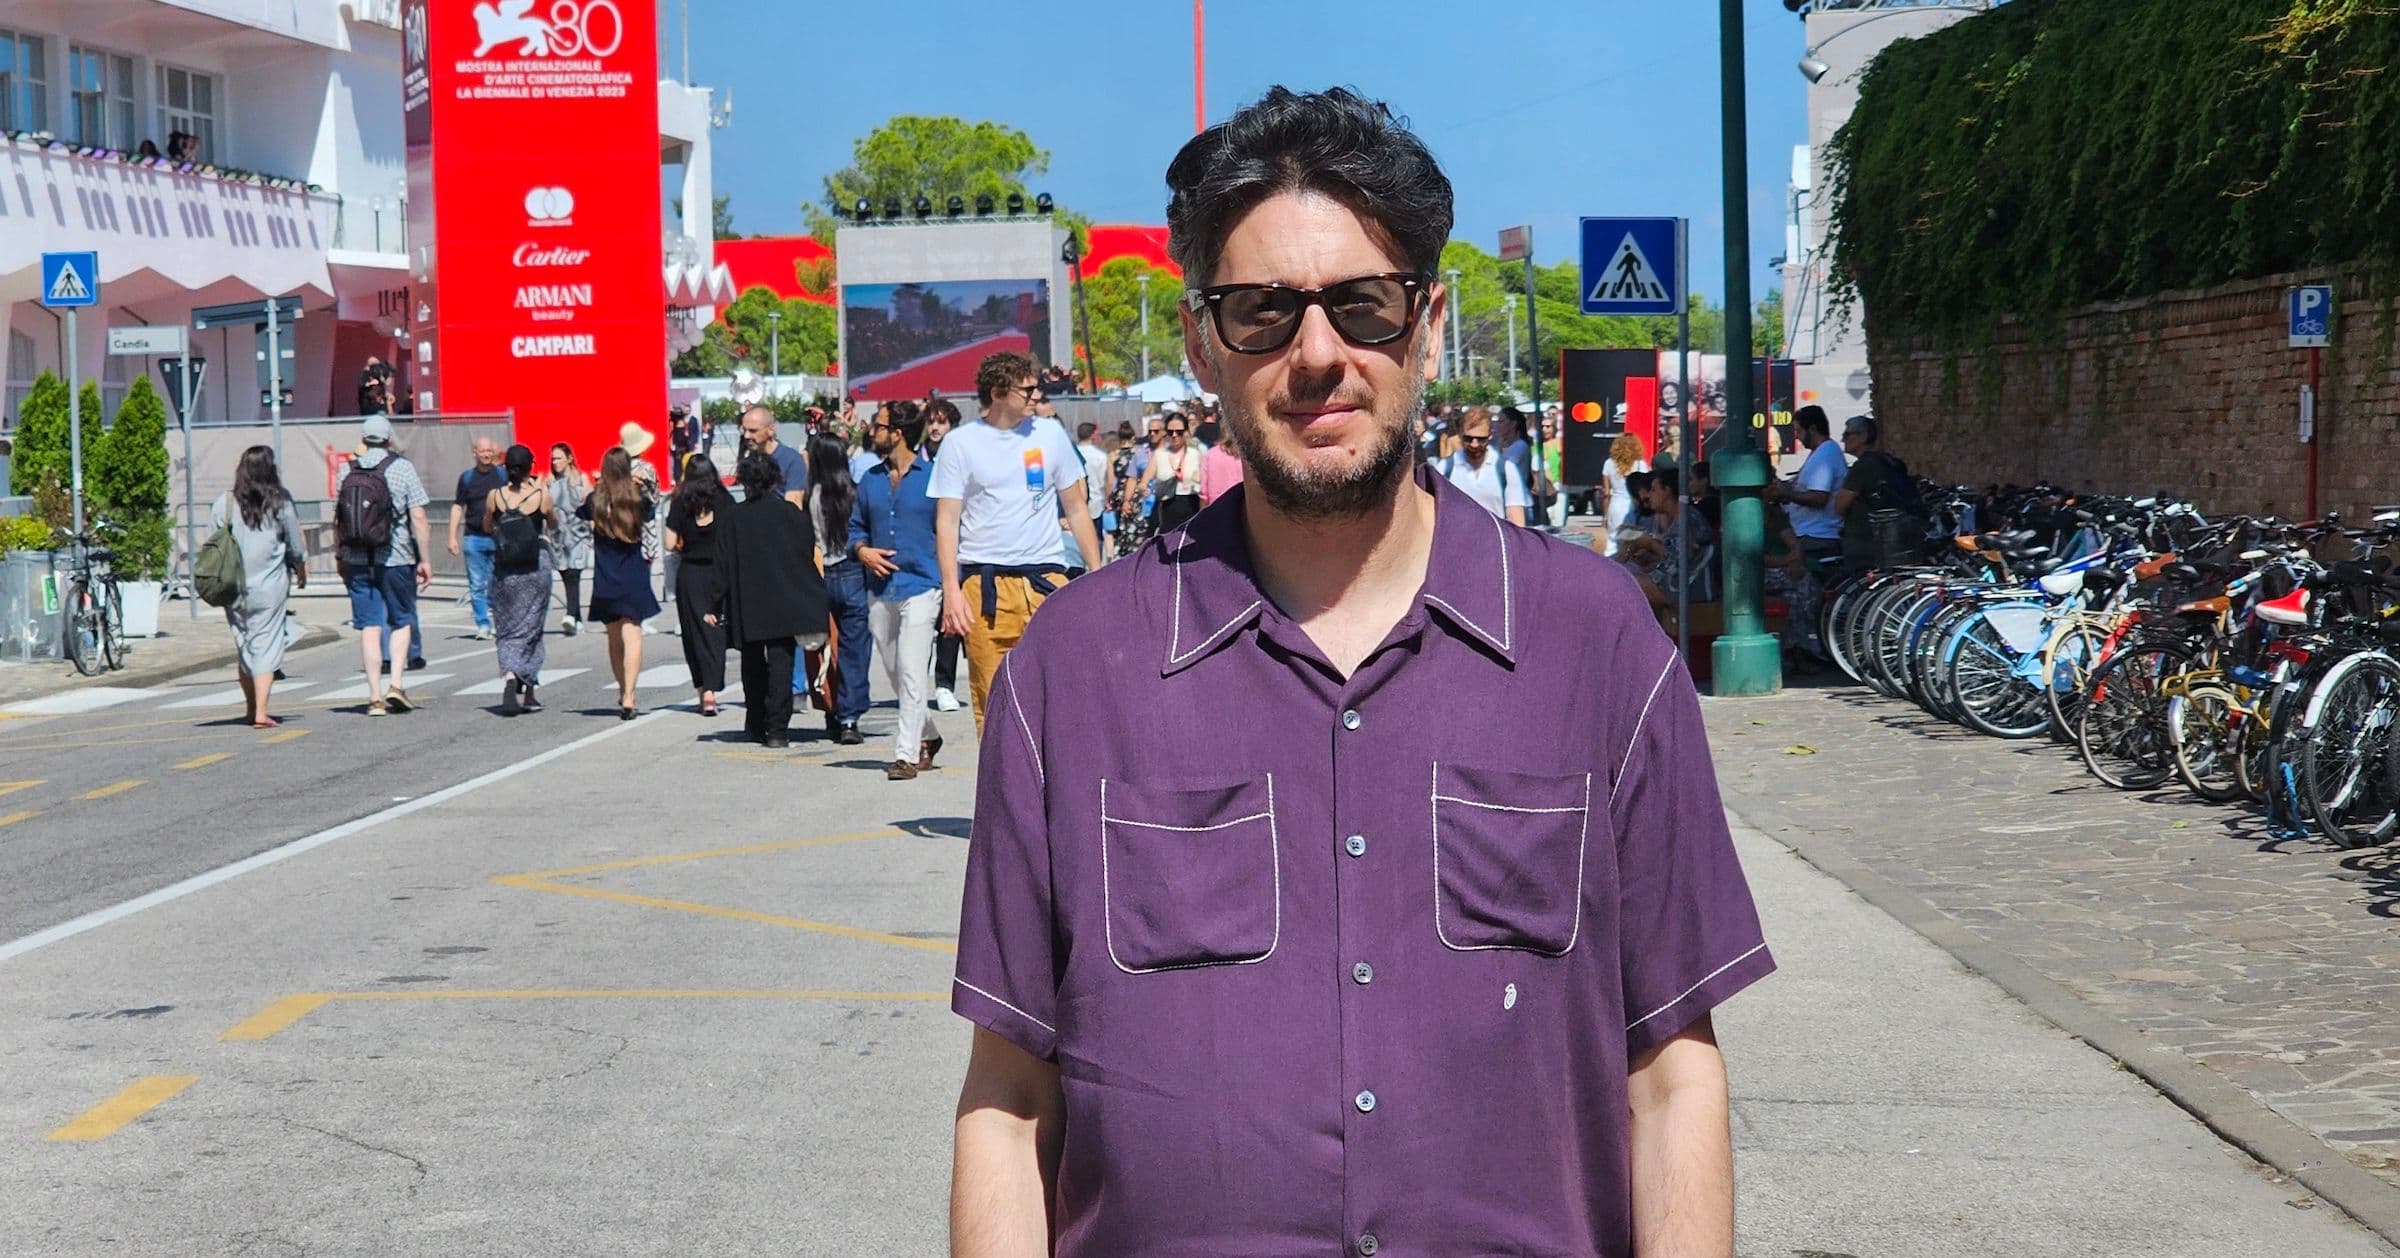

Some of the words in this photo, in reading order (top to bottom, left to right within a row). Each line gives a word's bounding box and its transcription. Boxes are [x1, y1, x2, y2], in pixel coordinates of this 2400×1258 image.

[549, 0, 623, 57] 80
[455, 61, 503, 73] MOSTRA
[505, 59, 602, 72] INTERNAZIONALE
[484, 74, 526, 86] D'ARTE
[527, 72, 633, 85] CINEMATOGRAFICA
[456, 88, 472, 99] LA
[474, 87, 530, 98] BIENNALE
[531, 87, 545, 98] DI
[547, 86, 595, 97] VENEZIA
[597, 86, 626, 97] 2023
[512, 241, 591, 267] Cartier
[514, 284, 593, 308] ARMANI
[2299, 289, 2321, 316] P
[532, 310, 574, 320] beauty
[511, 334, 597, 358] CAMPARI
